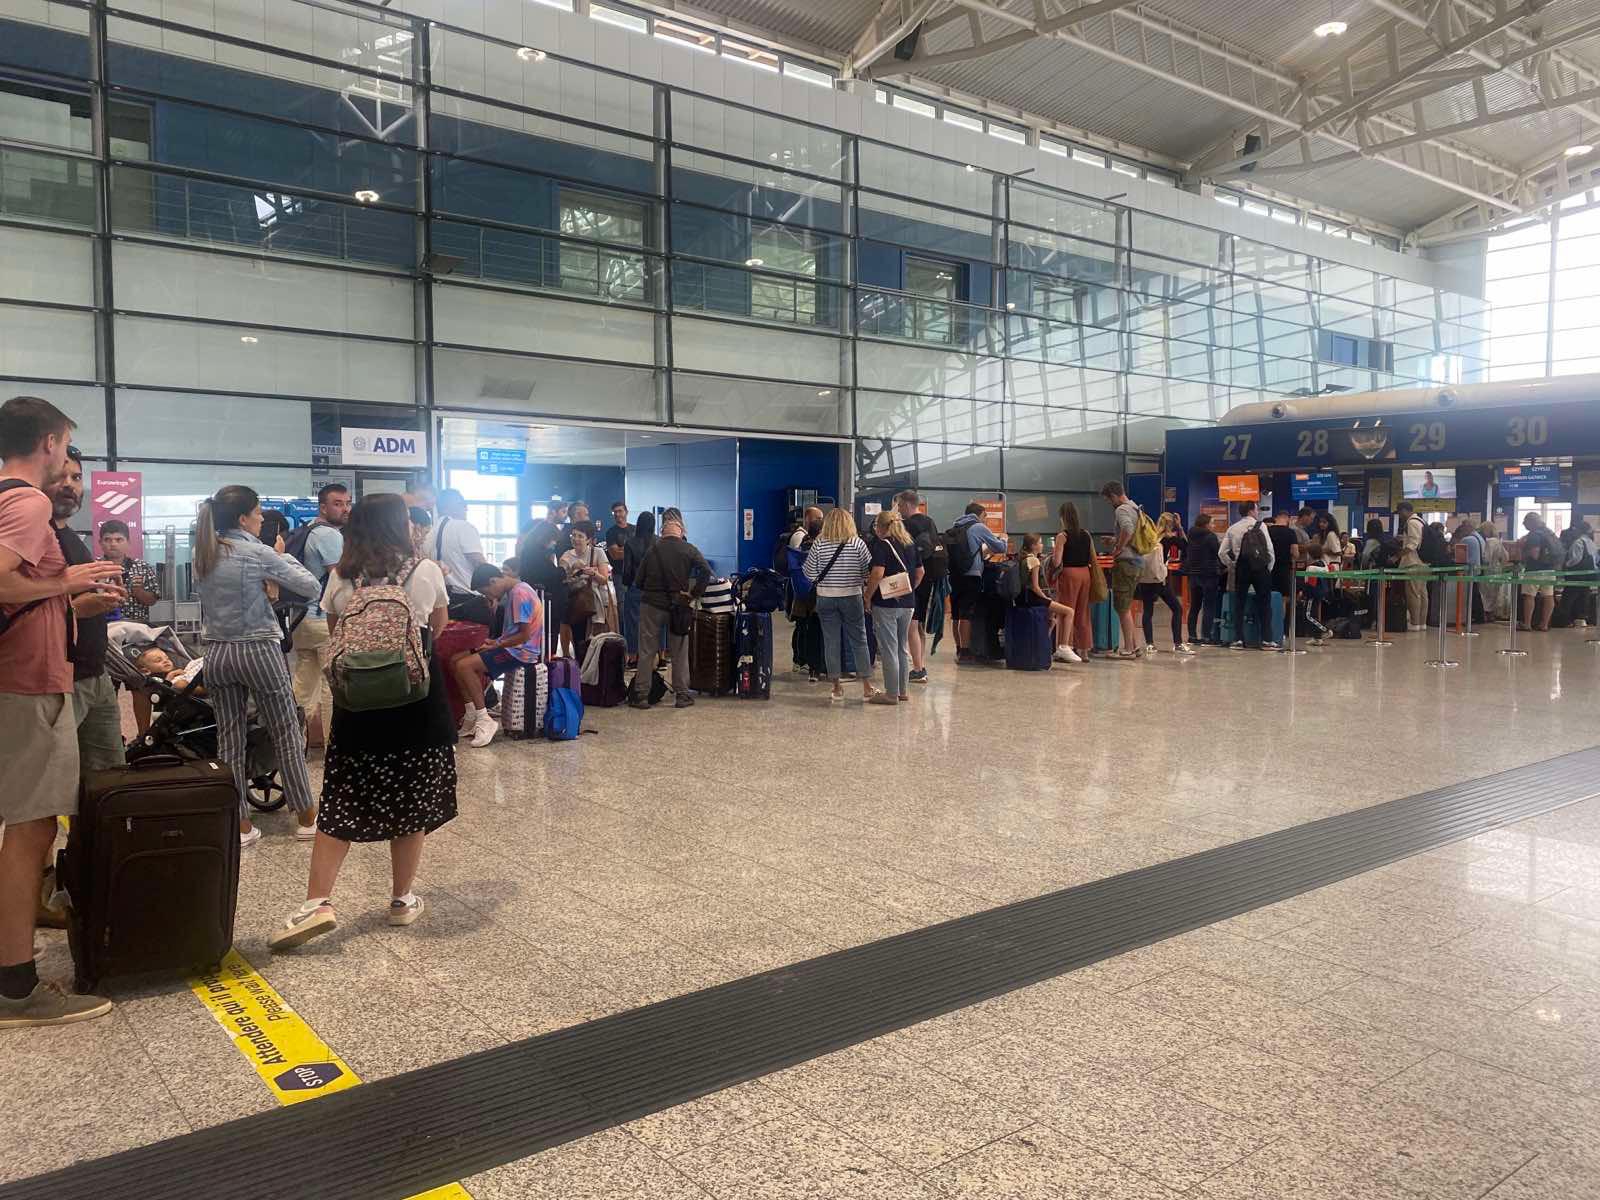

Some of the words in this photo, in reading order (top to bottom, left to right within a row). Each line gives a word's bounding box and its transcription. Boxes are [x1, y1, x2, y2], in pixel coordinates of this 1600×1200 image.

[1297, 429, 1329, 457] 28
[1408, 422, 1447, 452] 29
[1506, 415, 1548, 447] 30
[373, 437, 416, 454] ADM
[1223, 433, 1252, 460] 27
[255, 994, 290, 1021] Please
[234, 1015, 288, 1065] Attendere
[294, 1067, 324, 1087] STOP
